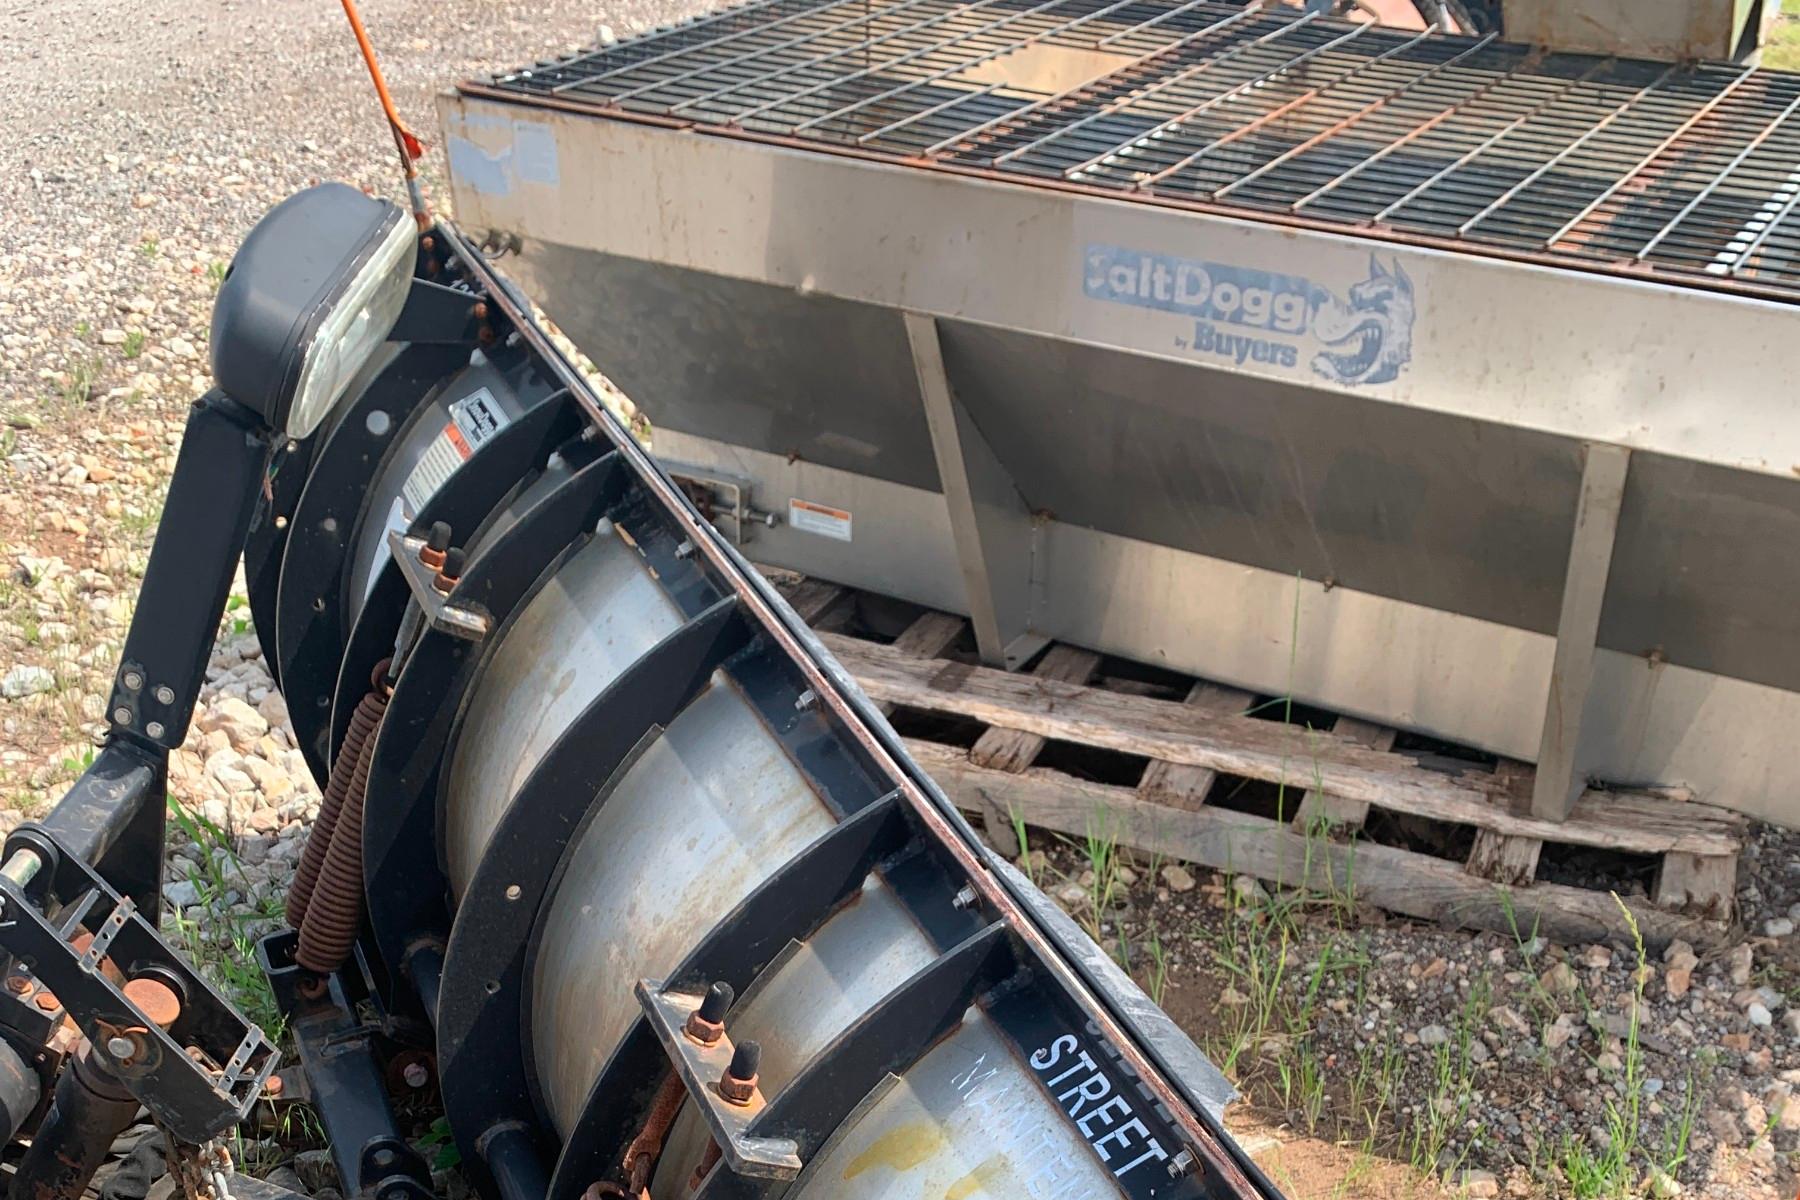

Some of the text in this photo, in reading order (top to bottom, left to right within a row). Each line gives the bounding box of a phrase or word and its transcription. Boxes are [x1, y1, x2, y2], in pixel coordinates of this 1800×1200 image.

[1086, 253, 1306, 331] SaltDogg
[1174, 321, 1298, 367] by Buyers
[1029, 1034, 1169, 1178] STREET
